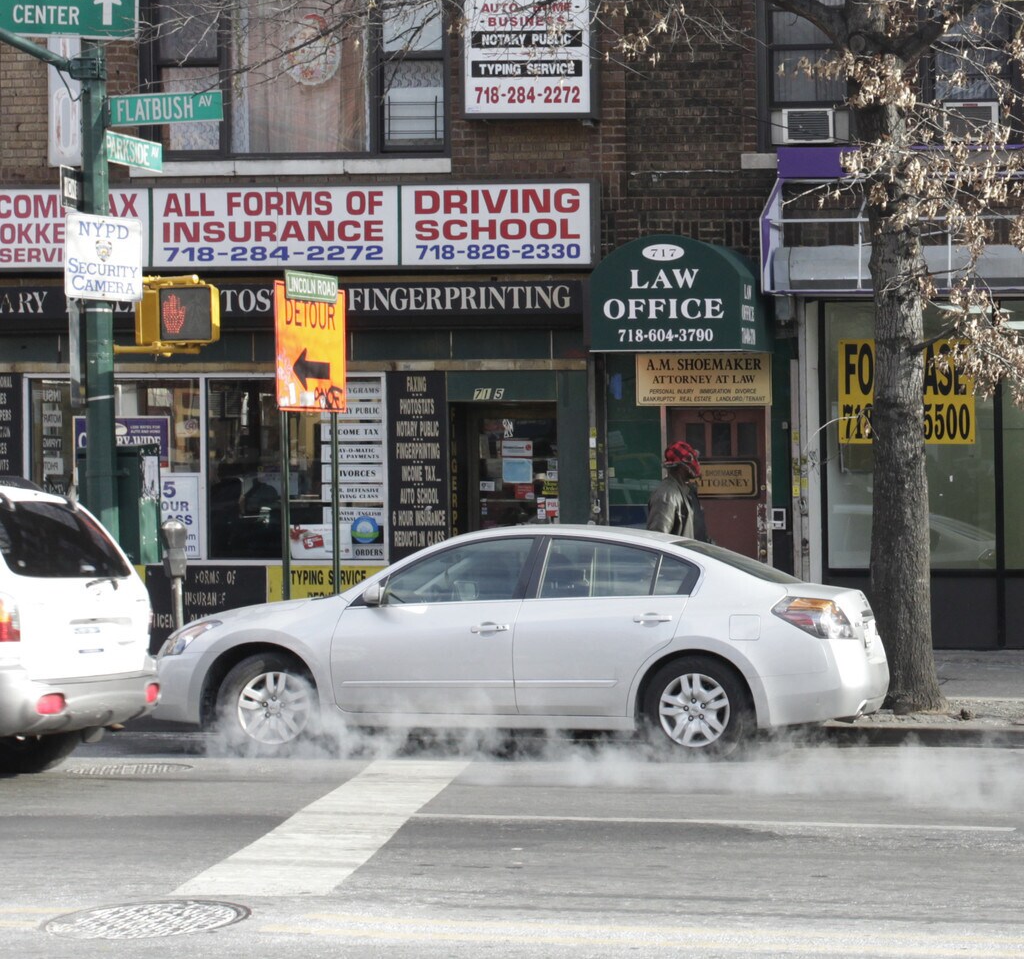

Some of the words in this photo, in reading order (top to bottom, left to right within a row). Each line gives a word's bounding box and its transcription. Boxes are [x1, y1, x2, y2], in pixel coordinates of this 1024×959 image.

[13, 5, 79, 25] CENTER
[480, 3, 518, 13] AUTO
[488, 16, 566, 26] BUSINESS
[482, 34, 526, 45] NOTARY
[532, 34, 572, 45] PUBLIC
[479, 64, 521, 74] TYPING
[527, 63, 575, 74] SERVICE
[475, 86, 580, 104] 718-284-2272
[117, 97, 193, 122] FLATBUSH
[199, 95, 212, 107] AV
[106, 135, 150, 166] PARKSIDE
[151, 146, 159, 158] AV
[163, 192, 215, 217] ALL
[227, 191, 332, 217] FORMS
[346, 190, 383, 215] OF
[414, 188, 580, 214] DRIVING
[78, 221, 129, 240] NYPD
[163, 220, 383, 242] INSURANCE
[415, 219, 580, 240] SCHOOL
[163, 245, 383, 262] 718-284-2272
[416, 244, 581, 260] 718-826-2330
[650, 248, 677, 257] 717
[68, 258, 138, 279] SECURITY
[71, 275, 136, 295] CAMERA
[288, 276, 316, 294] LINCOLN
[317, 281, 336, 296] ROAD
[630, 268, 699, 289] LAW
[348, 285, 571, 311] FINGERPRINTING
[286, 299, 335, 330] DETOUR
[603, 298, 724, 320] OFFICE
[618, 328, 713, 342] 718-604-3790
[646, 359, 674, 370] A.M.
[677, 358, 761, 370] SHOEMAKER
[845, 343, 873, 395] FO
[924, 344, 967, 395] ASE
[406, 376, 426, 392] FAXING
[652, 375, 712, 384] ATTORNEY
[715, 375, 730, 383] AT
[732, 374, 756, 383] LAW
[400, 398, 435, 415] PHOTOSTATS
[396, 421, 417, 437] NOTARY
[420, 421, 439, 437] PUBLIC
[396, 443, 440, 459] FINGERPRINTING
[401, 466, 422, 481] INCOME
[400, 488, 415, 504] AUTO
[417, 488, 439, 504] SCHOOL
[161, 502, 188, 511] OUR
[392, 511, 397, 526] 6
[398, 510, 414, 526] HOUR
[355, 548, 383, 556] ORDERS
[291, 570, 323, 585] TYPING
[328, 570, 366, 585] SRVICE
[185, 592, 225, 606] INSURANE
